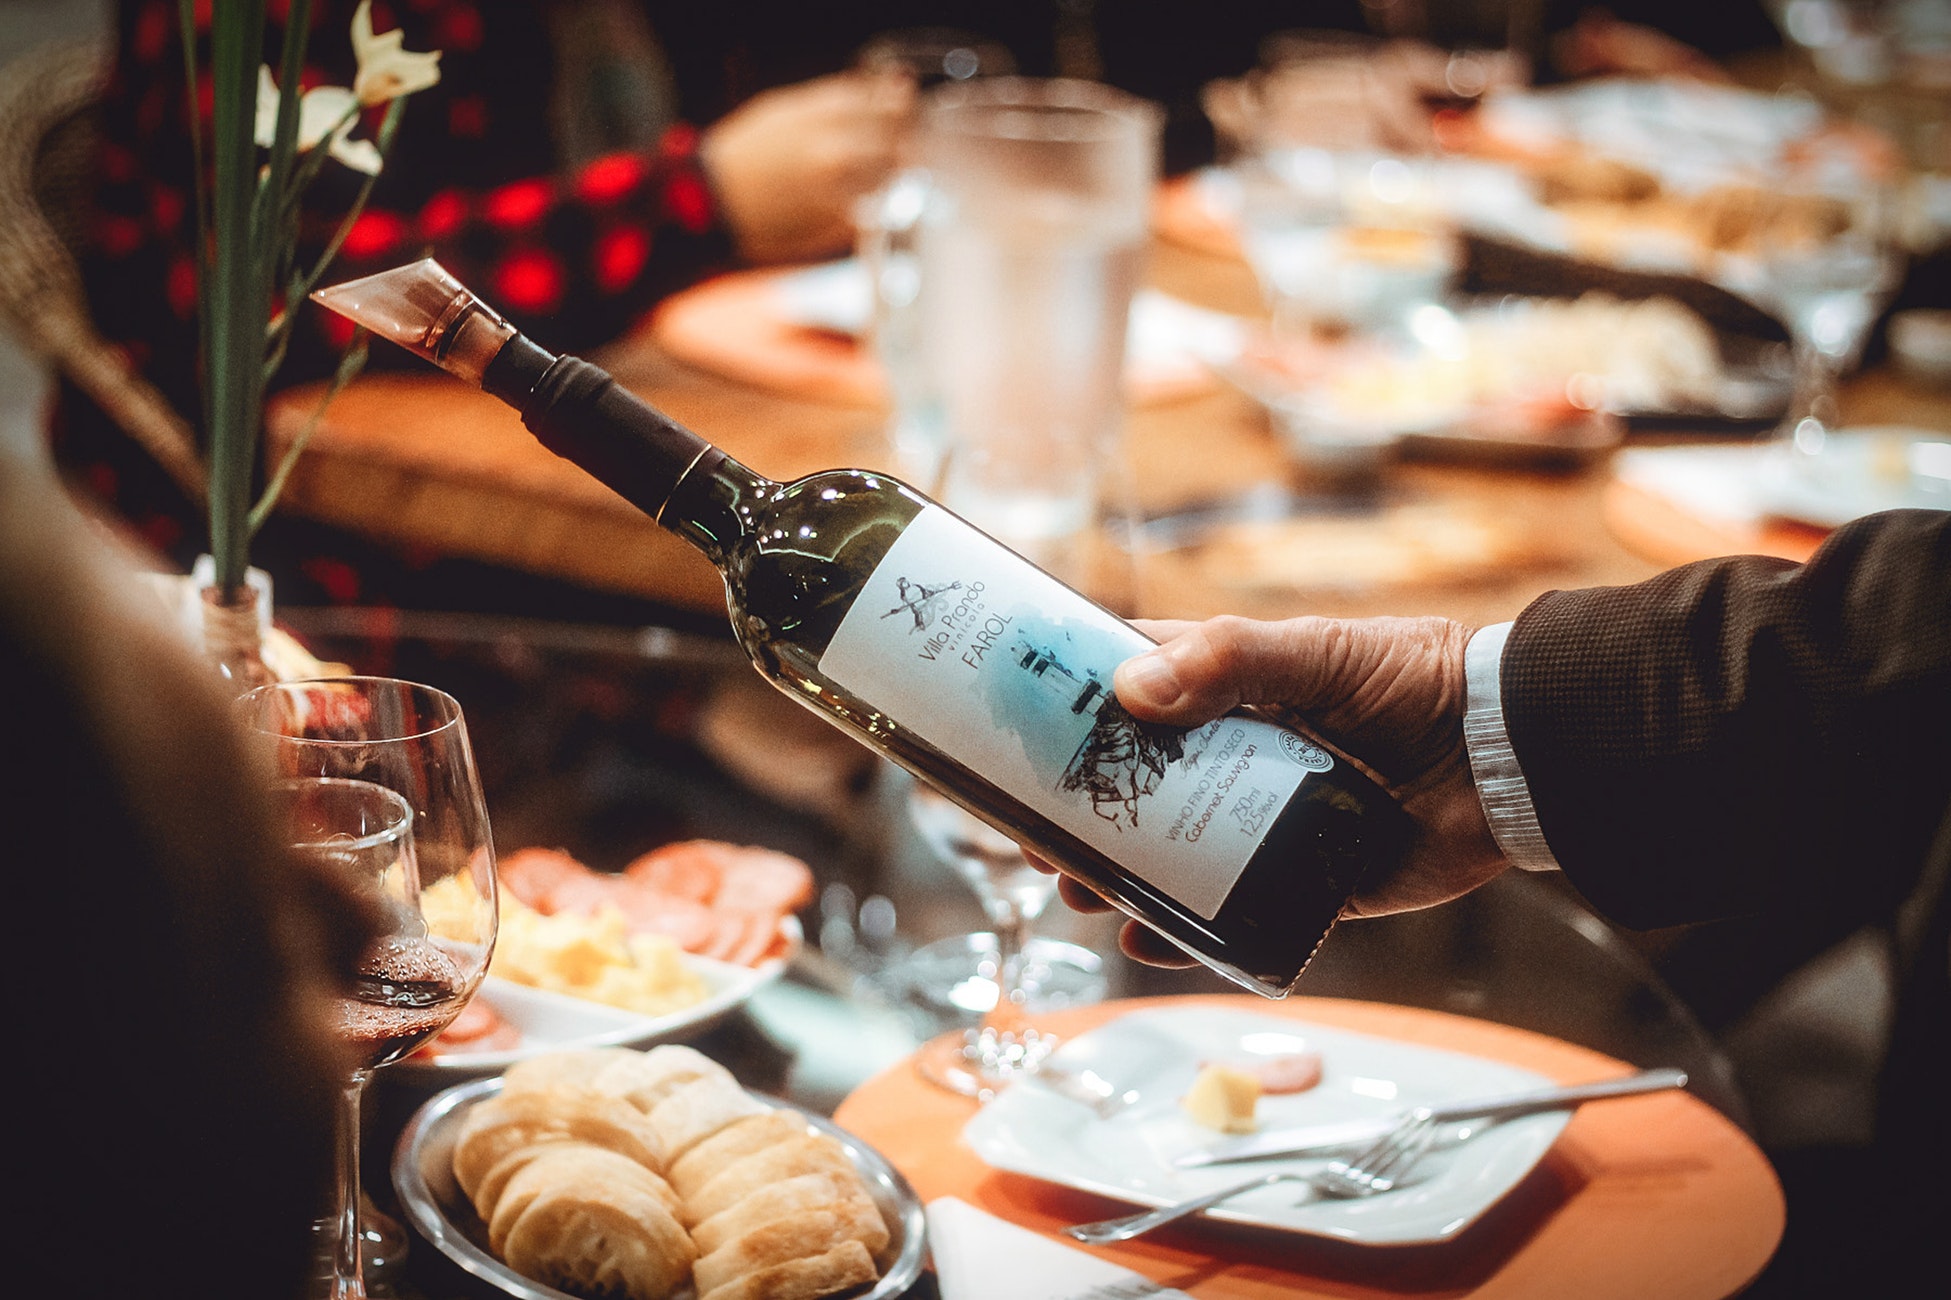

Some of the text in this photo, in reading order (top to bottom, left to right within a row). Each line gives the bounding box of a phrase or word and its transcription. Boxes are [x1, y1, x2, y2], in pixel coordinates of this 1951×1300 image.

[918, 581, 985, 661] Villa Prando
[961, 612, 1013, 670] FAROL
[1165, 805, 1194, 842] VINHO
[1187, 778, 1211, 808] FINO
[1205, 750, 1230, 781] TINTO
[1223, 728, 1246, 754] SECO
[1185, 792, 1225, 843] Cabernet
[1216, 743, 1258, 793] Sauvignon
[1229, 786, 1262, 823] 750ml
